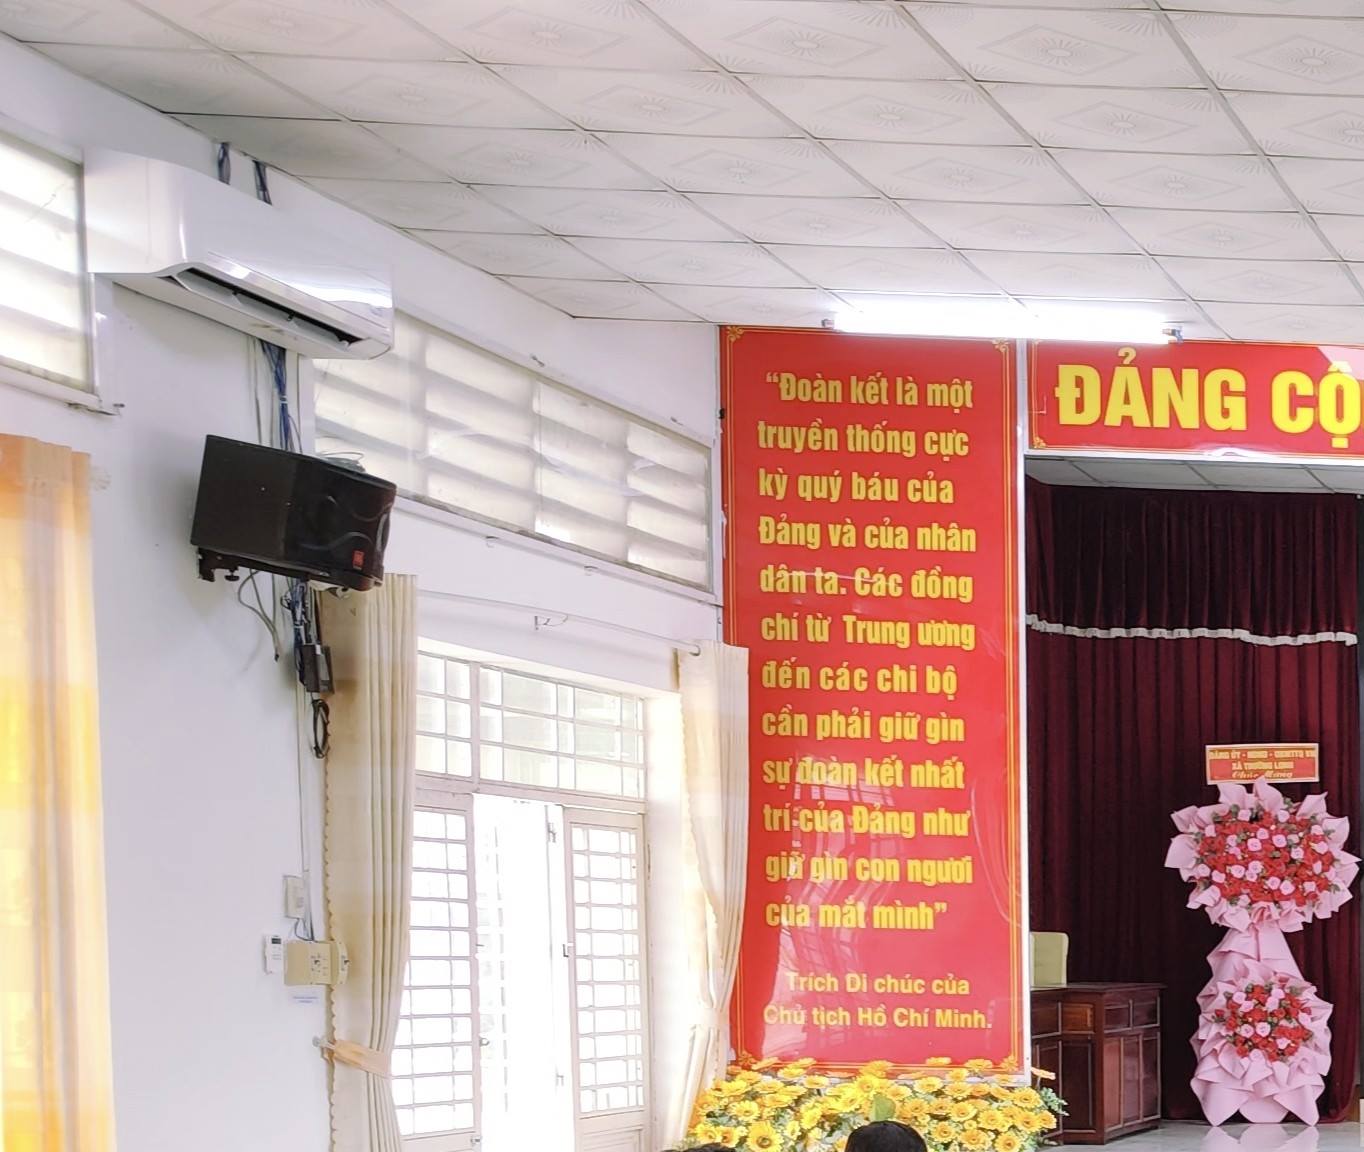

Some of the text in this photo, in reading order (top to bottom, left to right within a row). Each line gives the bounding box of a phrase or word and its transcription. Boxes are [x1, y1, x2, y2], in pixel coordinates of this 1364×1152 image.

[850, 372, 888, 404] kết
[896, 377, 918, 405] là
[927, 379, 973, 413] một
[1055, 347, 1246, 431] ĐẢNG
[758, 419, 969, 461] truyền thống cực
[759, 468, 953, 503] kỳ quý báu của
[759, 514, 976, 552] Đảng và của nhân
[760, 564, 973, 603] dân ta. Các đồng
[761, 613, 975, 650] chí từ Trung ương
[762, 657, 957, 700] đến các chi bộ
[762, 704, 964, 744] cần phải giữ gìn
[763, 755, 965, 790] sự đoàn kết nhất
[799, 801, 844, 832] của
[852, 803, 915, 838] Đảng
[923, 808, 971, 836] như
[811, 851, 848, 884] gìn
[856, 857, 899, 881] con
[766, 895, 810, 927] của
[819, 895, 866, 928] mắt
[786, 971, 970, 995] Trích Di chúc của
[763, 1002, 992, 1032] Chủ tịch Hồ Chí Minh.
